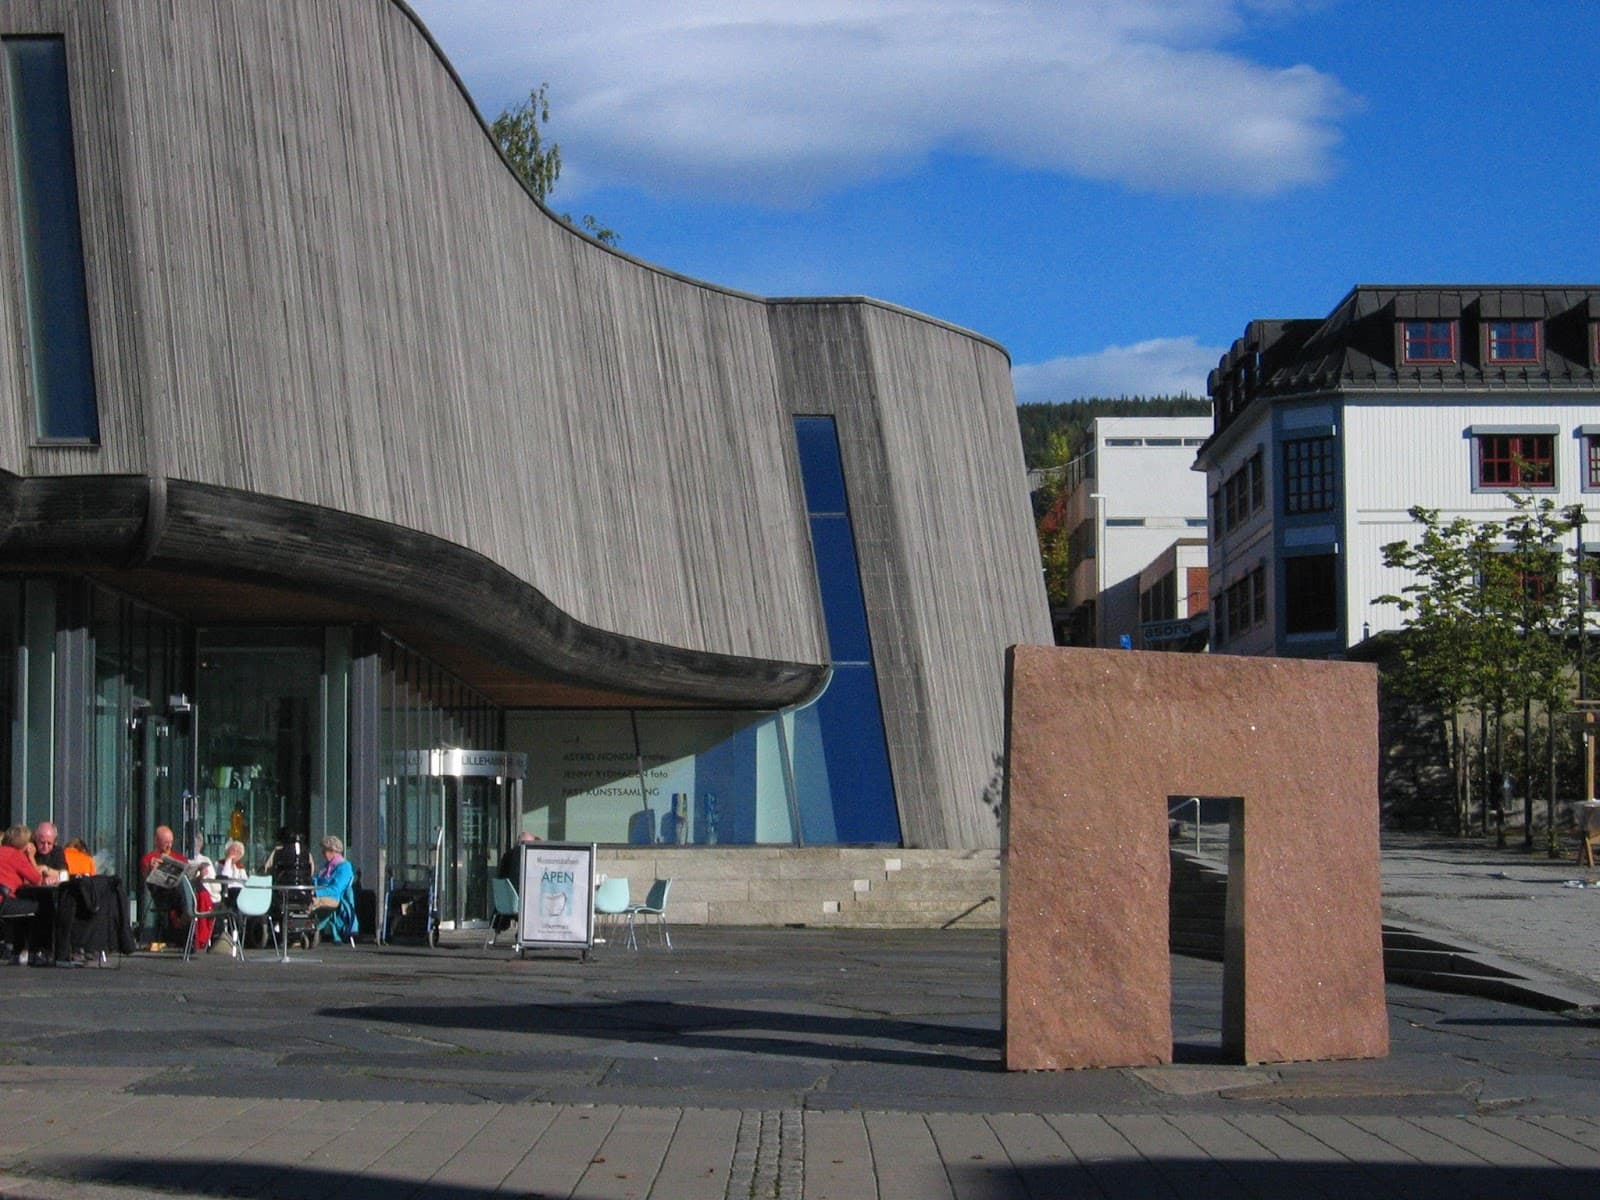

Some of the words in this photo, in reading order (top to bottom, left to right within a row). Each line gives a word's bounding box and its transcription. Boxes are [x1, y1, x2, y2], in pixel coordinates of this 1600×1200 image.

[650, 769, 669, 778] foto
[587, 787, 660, 797] KUNSTSAMLNG
[541, 866, 575, 884] ÅPEN
